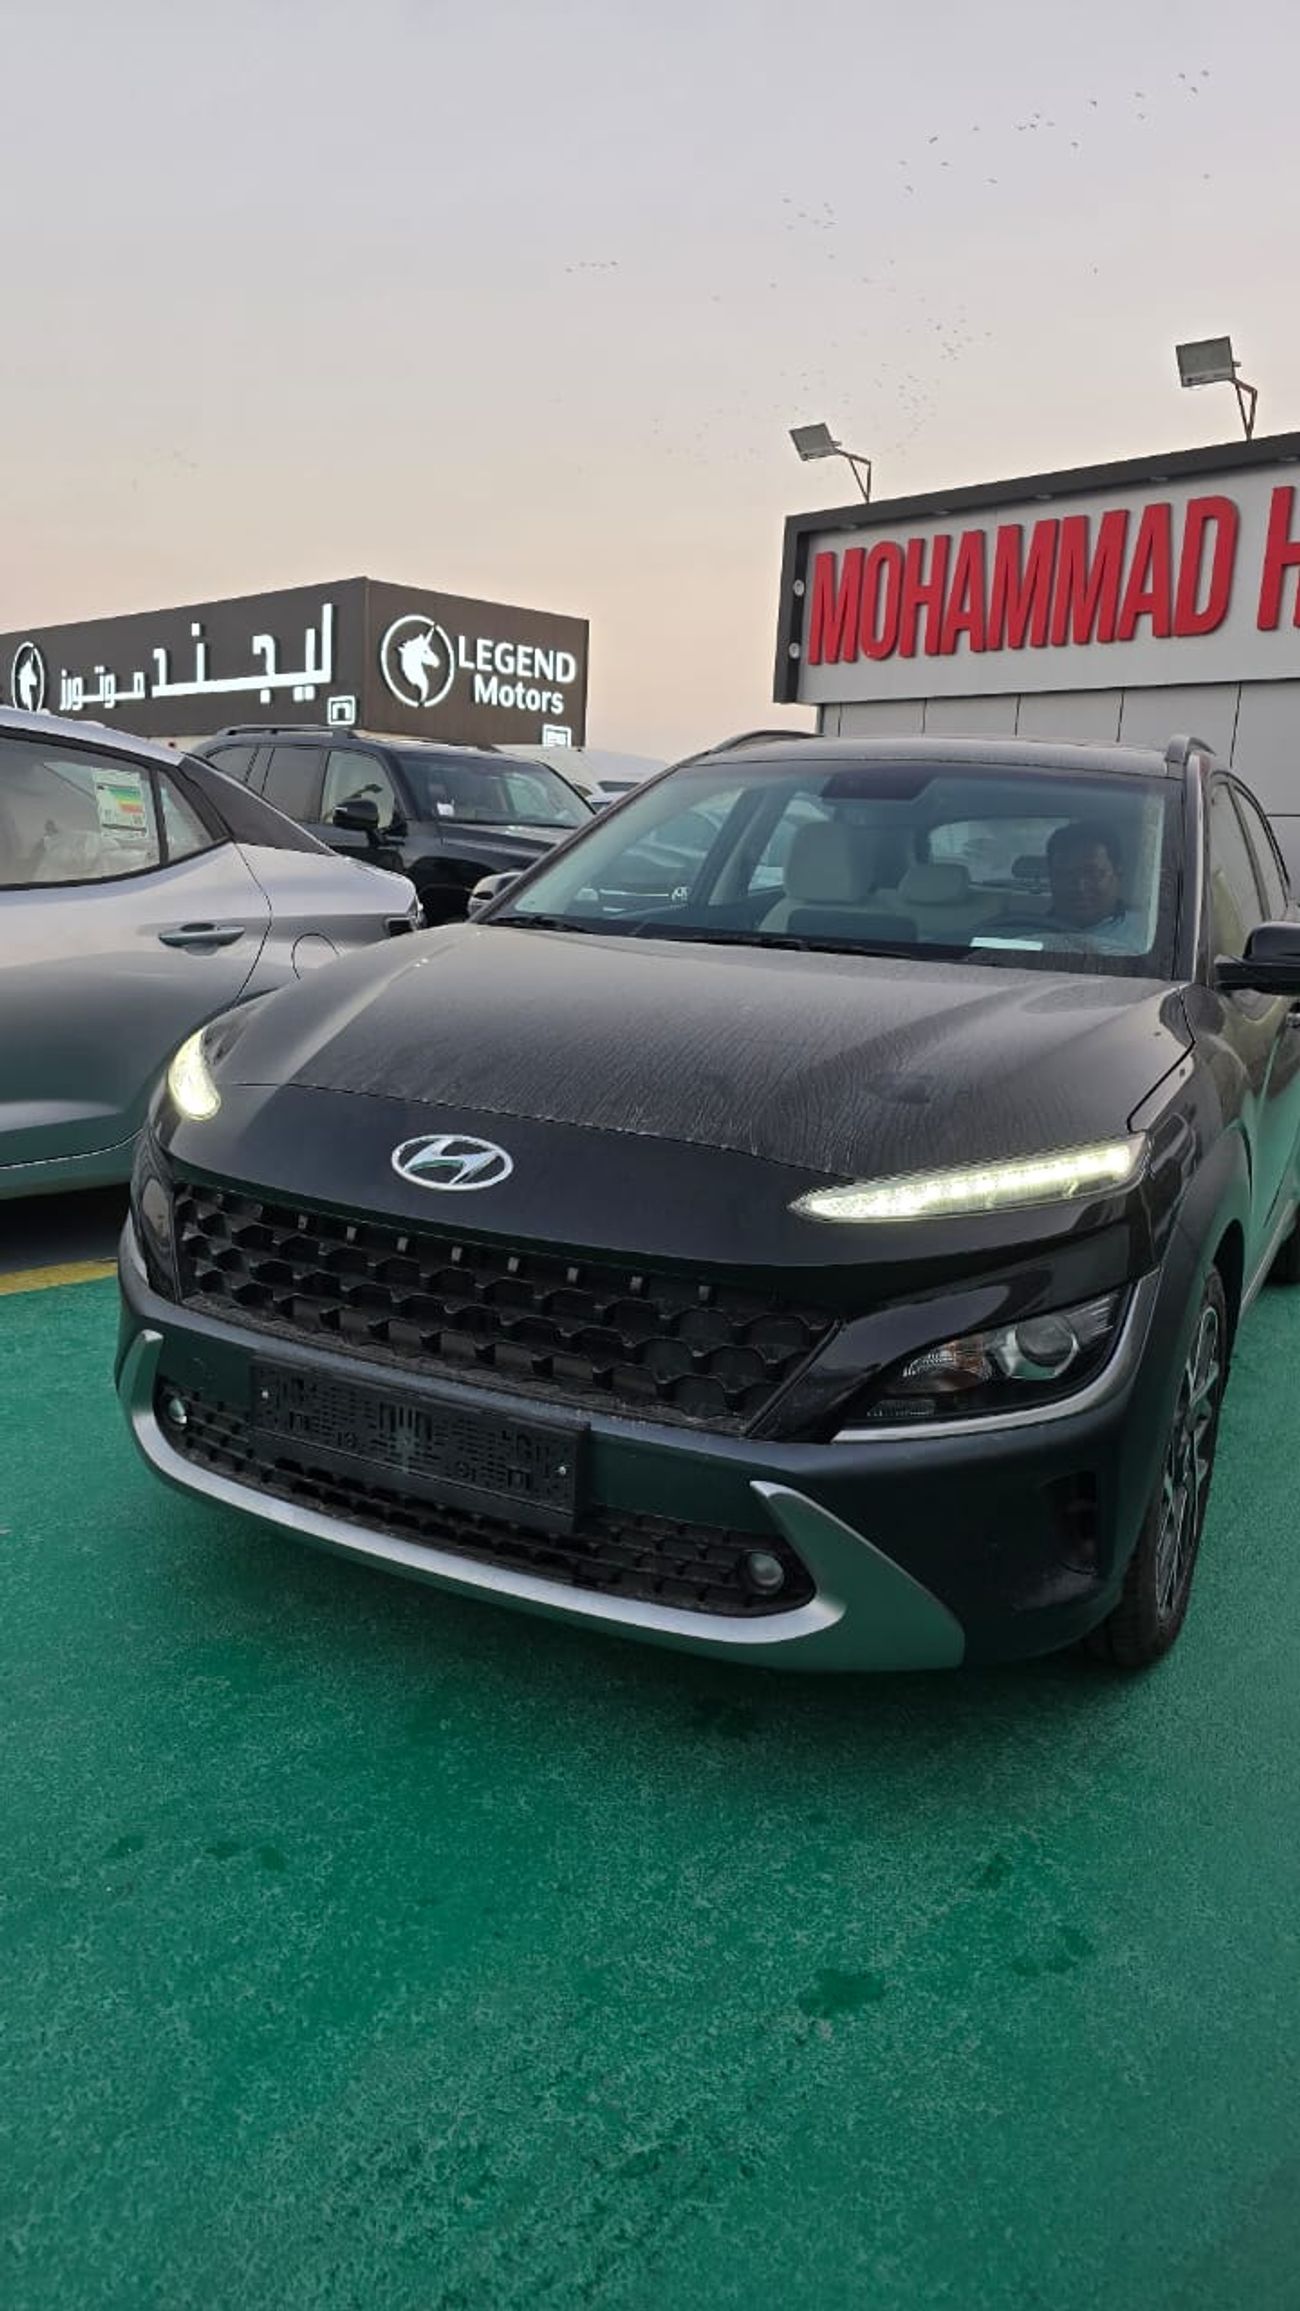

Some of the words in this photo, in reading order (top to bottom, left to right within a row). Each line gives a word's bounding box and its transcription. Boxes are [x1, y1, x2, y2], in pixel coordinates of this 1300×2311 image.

[808, 496, 1240, 666] MOHAMMAD
[151, 602, 333, 704] ليجند
[457, 635, 577, 684] LEGEND
[59, 665, 145, 711] موتورز
[473, 673, 565, 716] Motors
